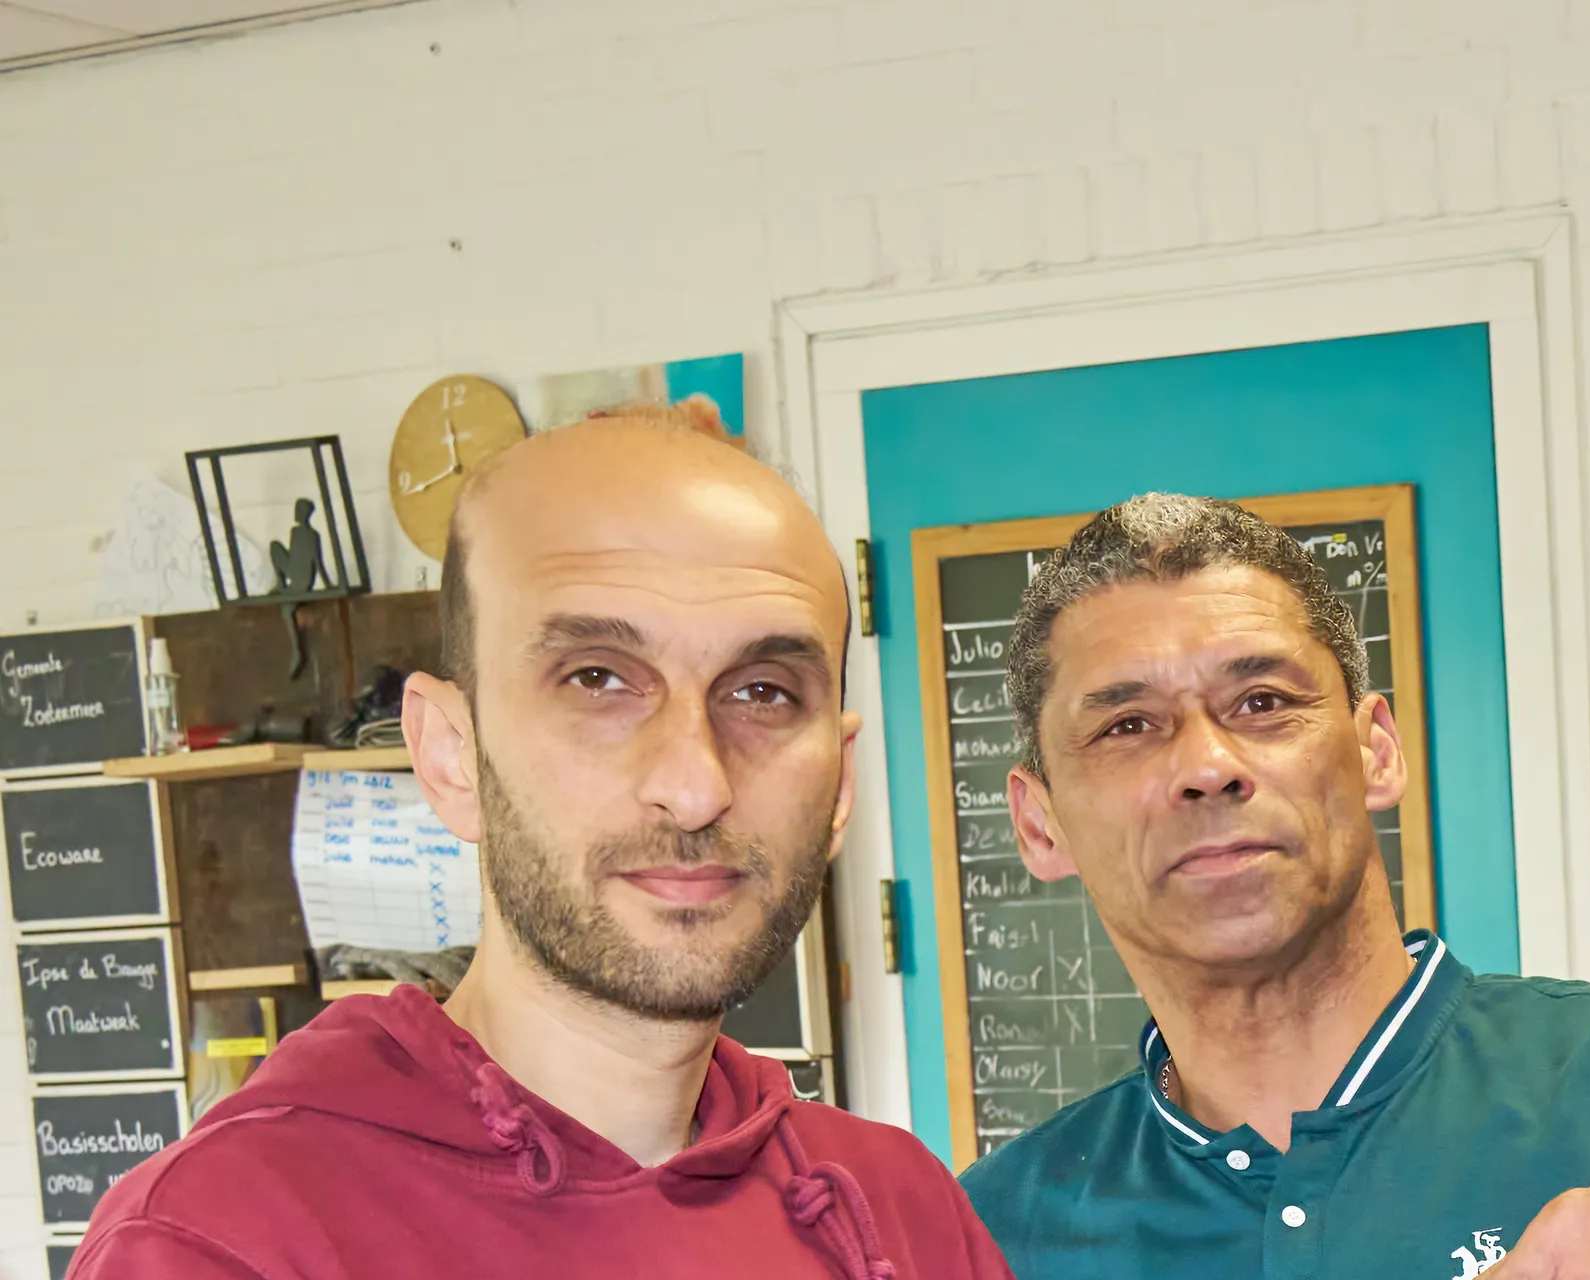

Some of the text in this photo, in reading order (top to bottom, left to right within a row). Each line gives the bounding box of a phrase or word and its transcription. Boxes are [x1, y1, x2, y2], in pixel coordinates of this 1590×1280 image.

[950, 630, 1004, 666] Julio
[956, 780, 1008, 808] Siam
[977, 962, 1043, 991] Noor
[37, 1118, 164, 1157] Basisscholen
